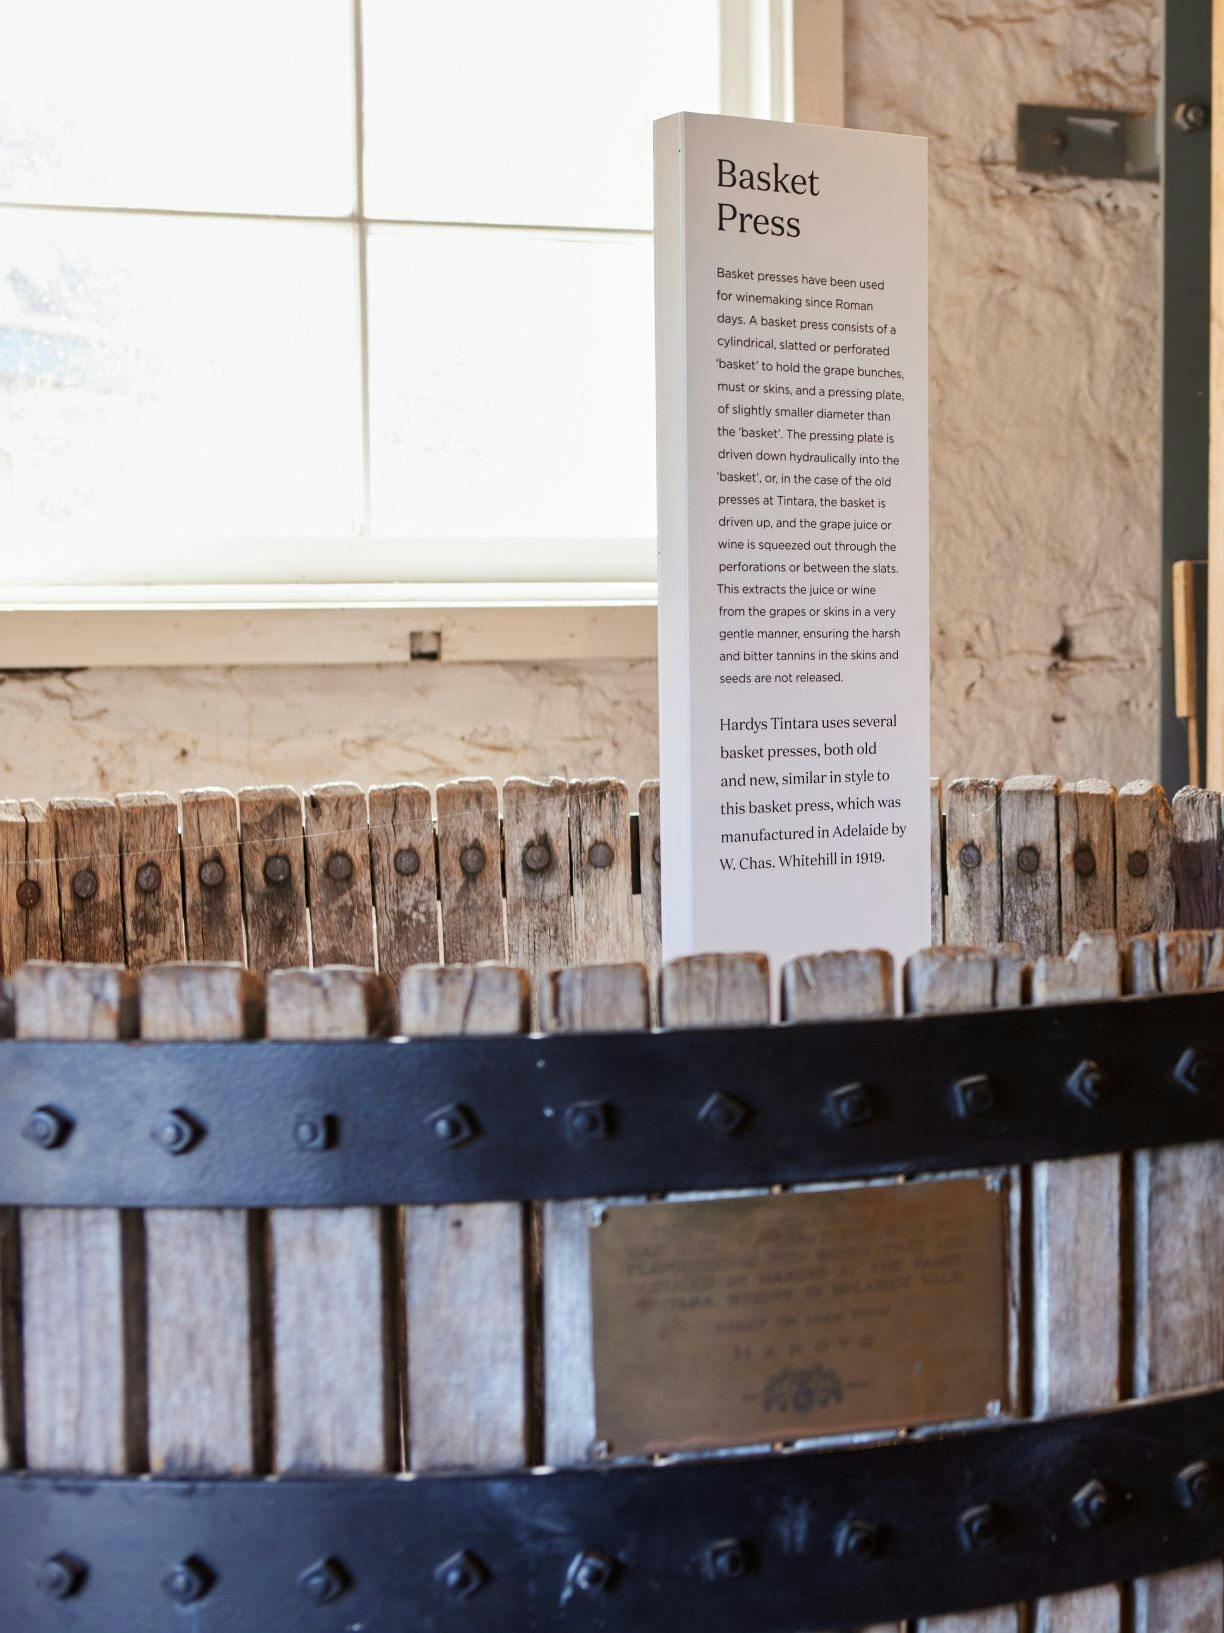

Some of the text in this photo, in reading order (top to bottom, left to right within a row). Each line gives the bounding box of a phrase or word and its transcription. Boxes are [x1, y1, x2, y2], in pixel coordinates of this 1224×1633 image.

[717, 158, 819, 196] Basket
[717, 202, 800, 238] Press
[716, 267, 884, 291] Basket presses have been used
[716, 289, 873, 311] for winemaking since Roman
[716, 312, 896, 335] days. A basket press consists of a
[717, 336, 890, 356] cylindrical, slatted or perforated
[761, 361, 773, 371] to
[775, 361, 800, 373] hold
[802, 363, 821, 374] the
[823, 366, 854, 377] grape
[857, 365, 904, 380] bunches,
[717, 382, 904, 402] must or skins, and a pressing plate,
[717, 403, 890, 422] of slightly smaller diameter than
[717, 425, 736, 437] the
[786, 428, 806, 440] The
[809, 431, 854, 444] pressing
[857, 432, 883, 444] plate
[886, 433, 894, 444] is
[717, 448, 899, 466] driven down hydraulically into the
[764, 474, 778, 484] or,
[781, 472, 791, 484] in
[793, 473, 811, 485] the
[813, 476, 839, 485] case
[841, 475, 852, 486] of
[855, 475, 872, 486] the
[874, 476, 891, 487] old
[718, 495, 886, 509] presses at Tintara, the basket is
[718, 516, 892, 531] driven up, and the grape juice or
[717, 538, 897, 553] wine is squeezed out through the
[718, 560, 899, 574] perforations or between the slats.
[716, 583, 876, 597] This extracts the juice or wine
[718, 605, 896, 619] from the grapes or skins in a very
[718, 627, 901, 641] gentle manner, ensuring the harsh
[719, 649, 899, 662] and bitter tannins in the skins and
[719, 671, 843, 684] seeds are not released.
[720, 713, 897, 734] Hardys Tintara uses several
[720, 741, 877, 761] basket presses, both old
[720, 768, 890, 787] and new, similar in style to
[720, 796, 901, 815] this basket press, which was
[721, 822, 907, 843] manufactured in Adelaide by
[719, 851, 885, 870] W. Chas. Whitehill in 1919.
